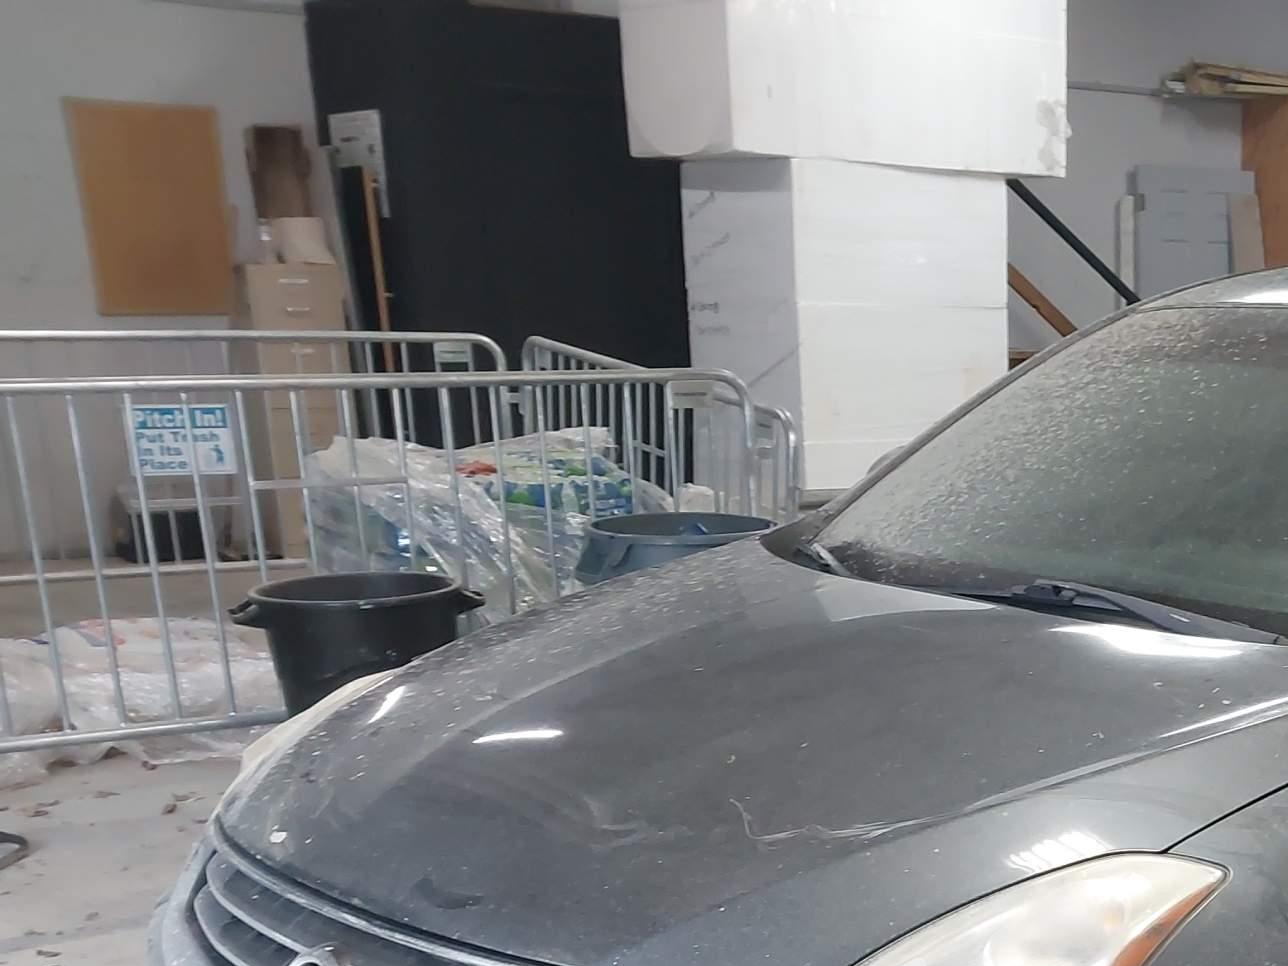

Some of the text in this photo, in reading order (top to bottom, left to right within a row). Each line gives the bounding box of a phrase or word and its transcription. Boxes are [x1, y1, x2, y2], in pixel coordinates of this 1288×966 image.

[133, 408, 224, 428] Pitch In!
[135, 431, 165, 443] Put
[159, 445, 183, 456] Its
[139, 458, 188, 470] Place
